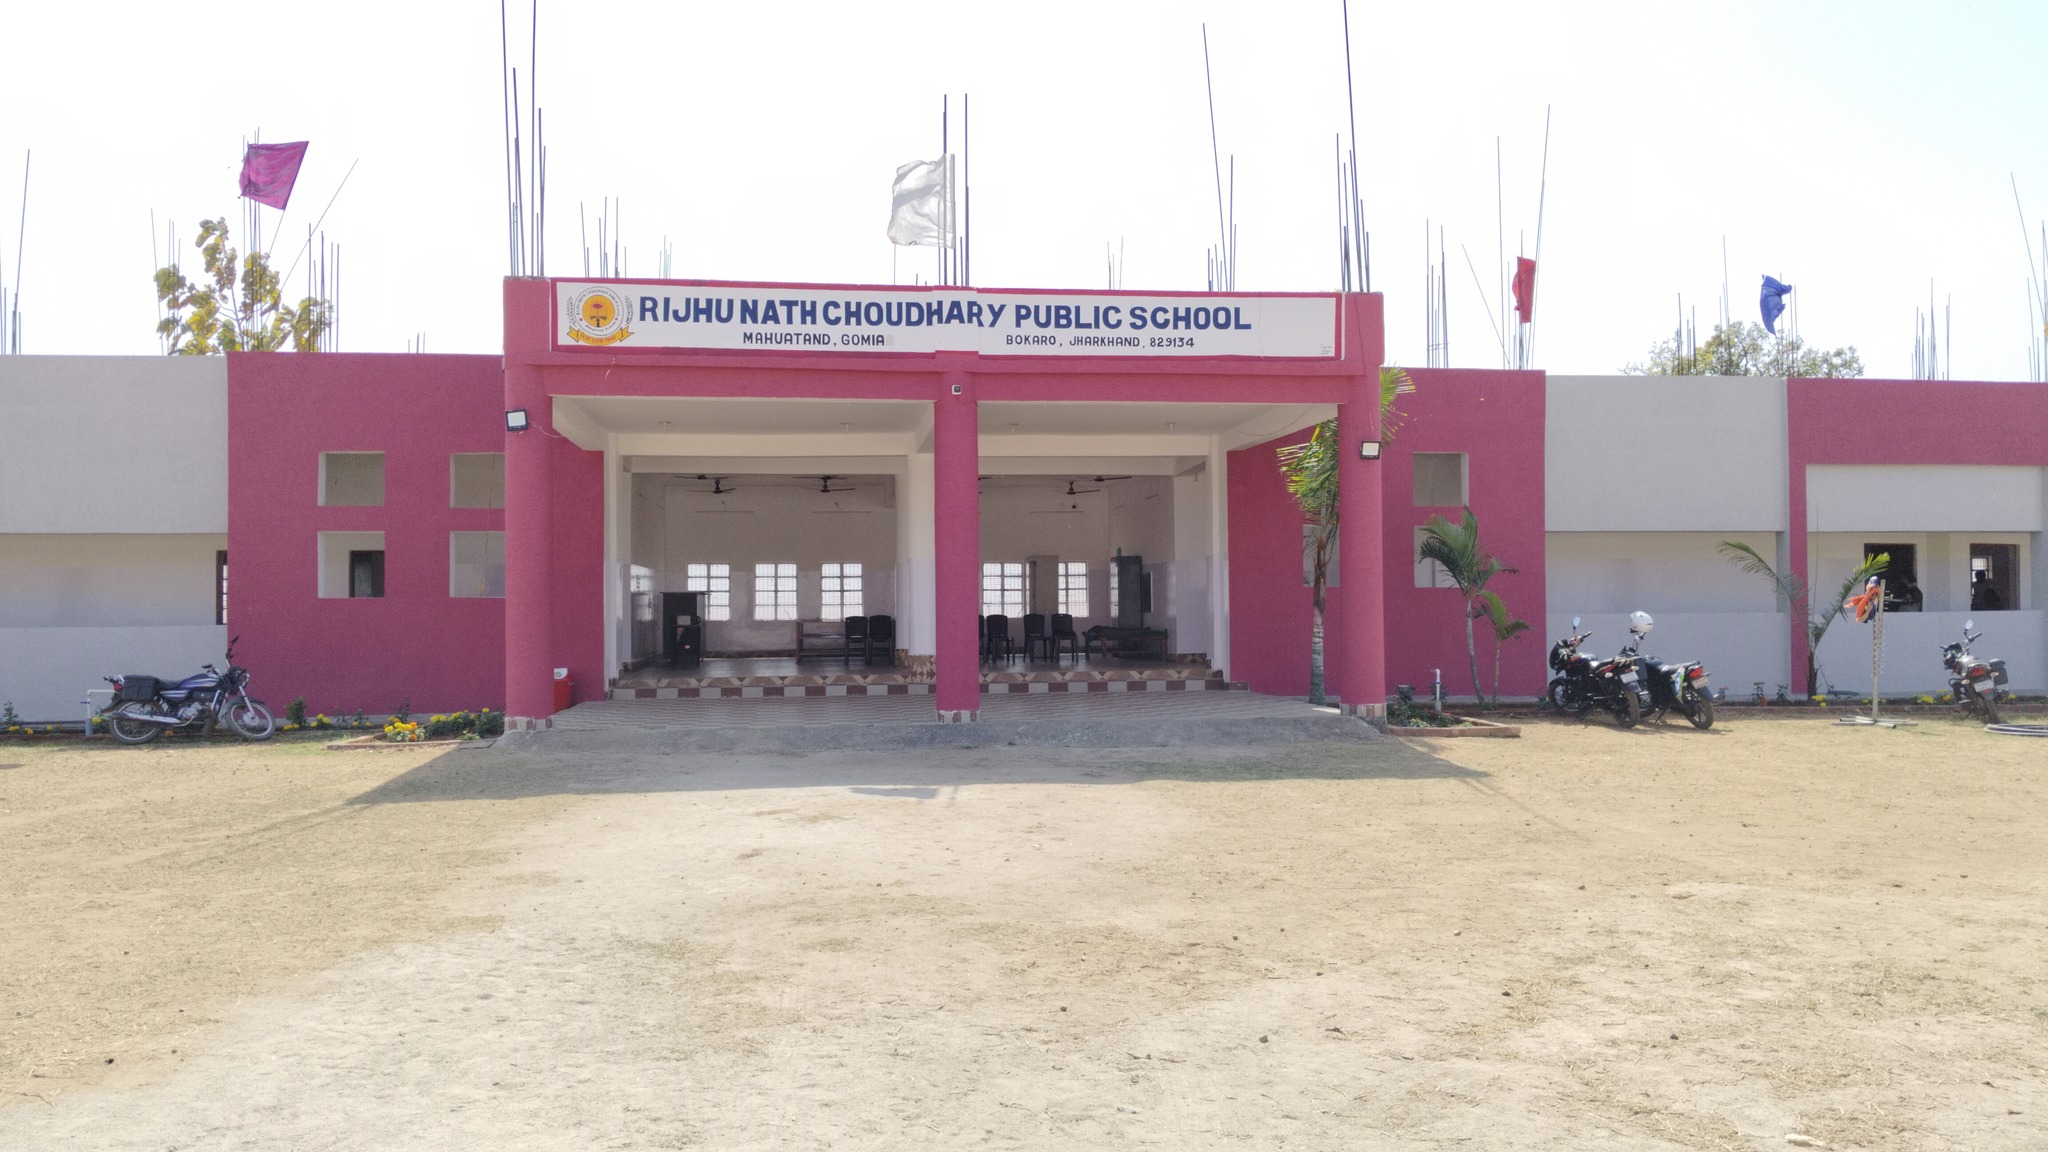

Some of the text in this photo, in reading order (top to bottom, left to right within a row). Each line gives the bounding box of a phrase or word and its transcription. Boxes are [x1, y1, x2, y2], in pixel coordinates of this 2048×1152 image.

[1014, 304, 1123, 330] PUBLIC
[1129, 306, 1252, 331] SCHOOL
[841, 333, 885, 347] GOMIA
[1149, 337, 1195, 348] 829134
